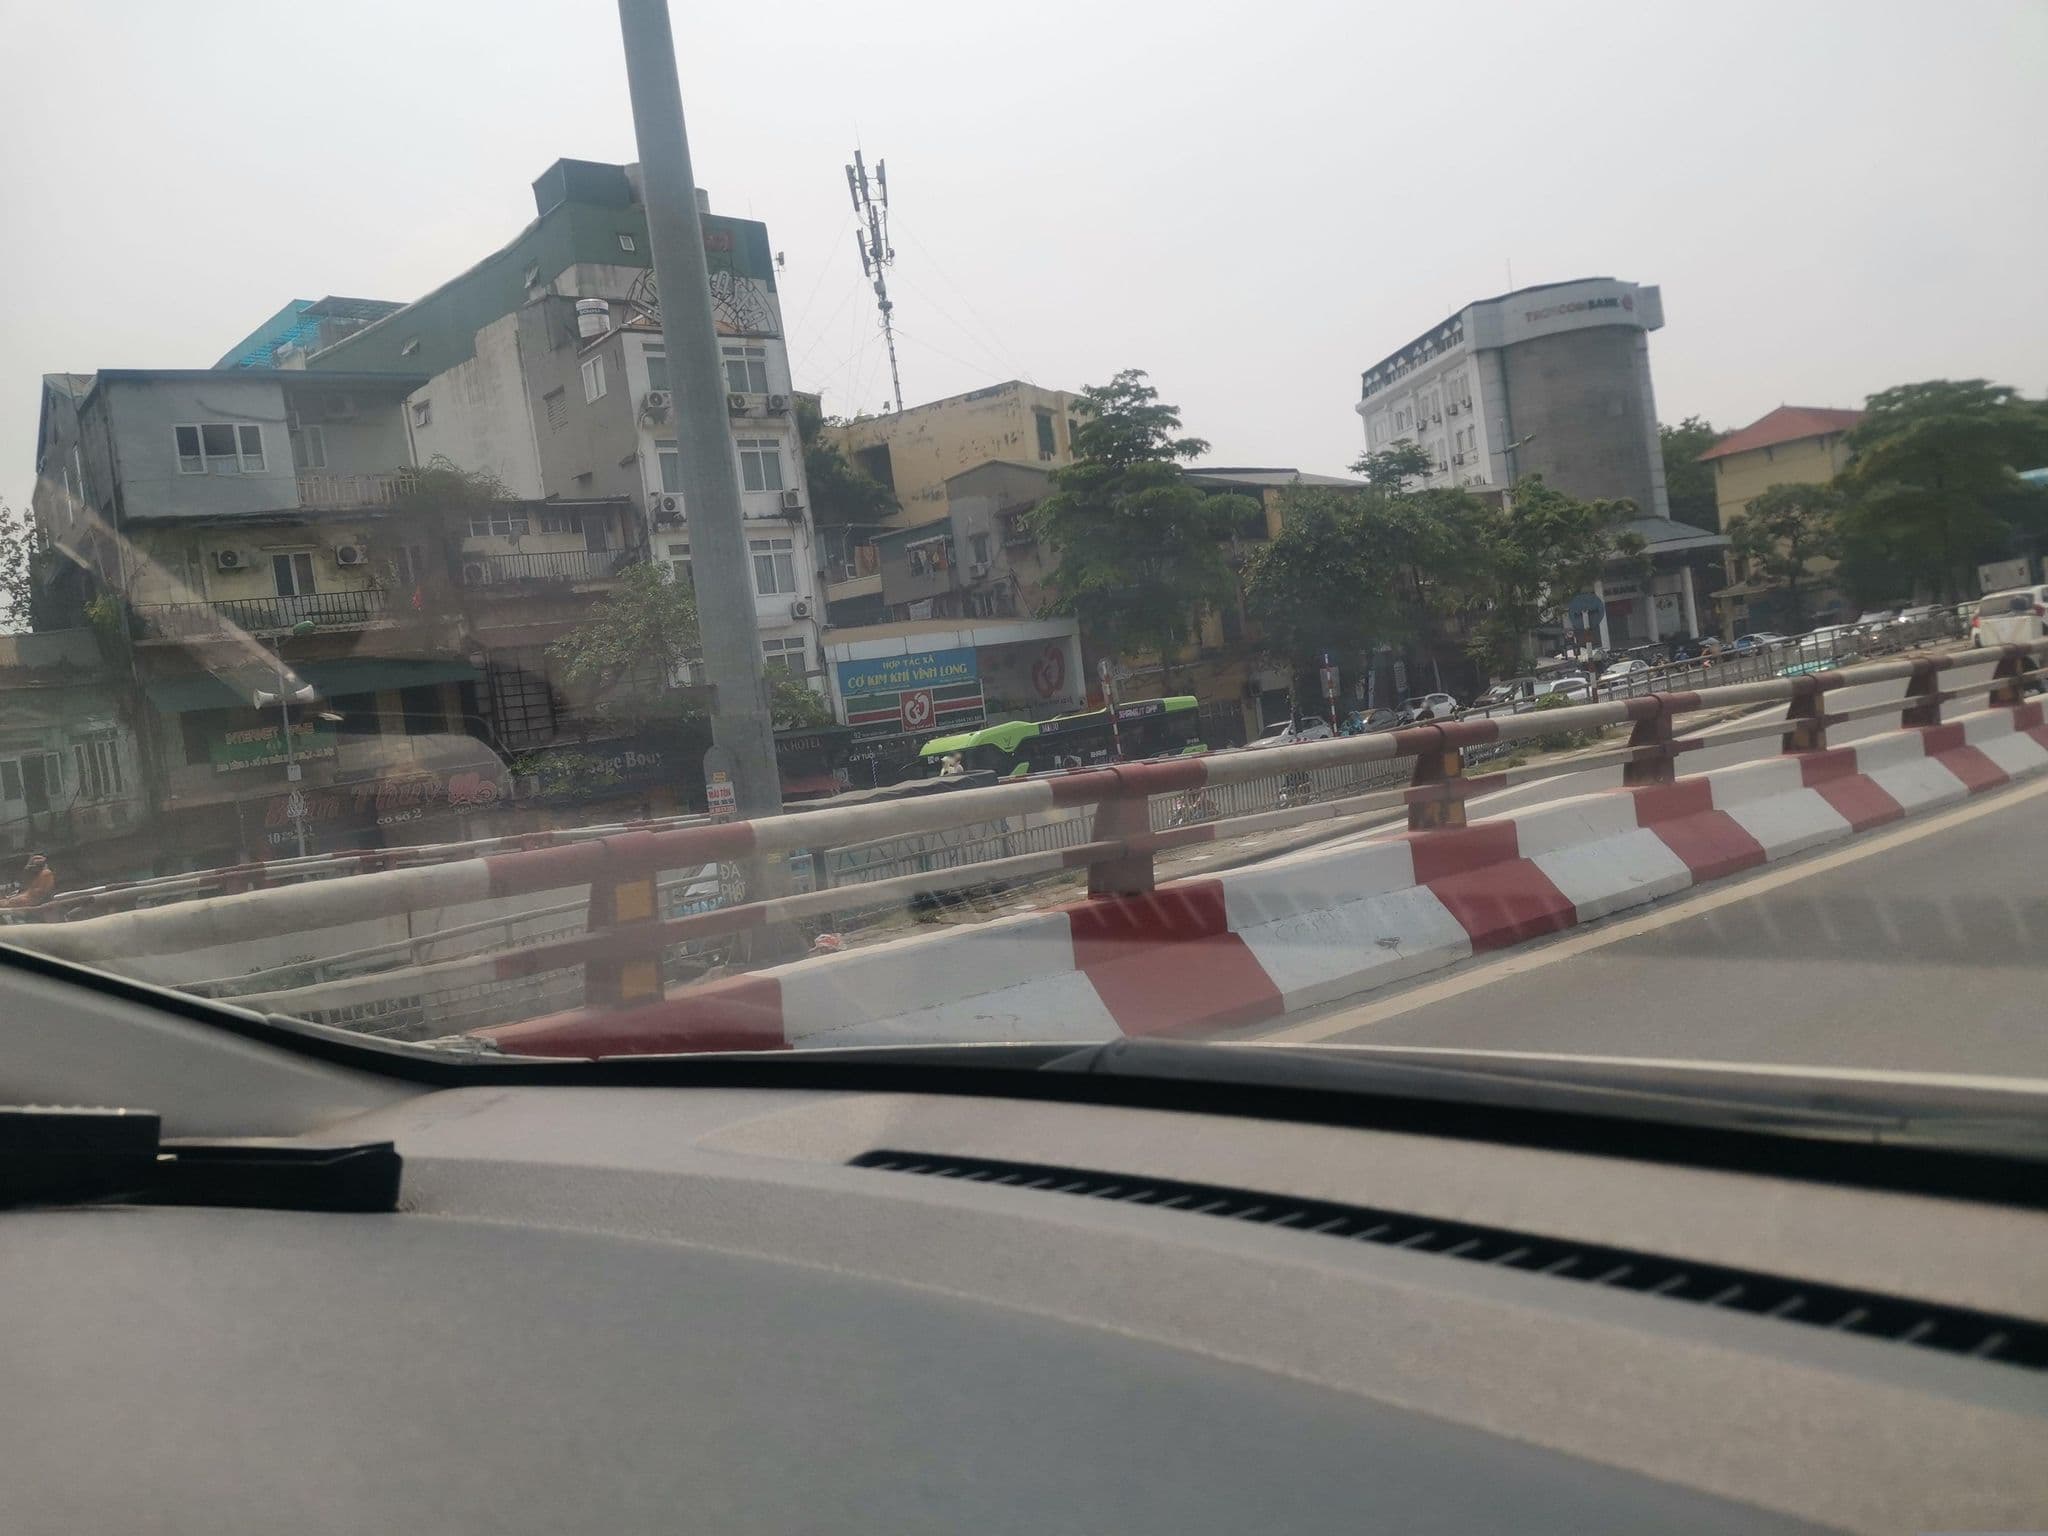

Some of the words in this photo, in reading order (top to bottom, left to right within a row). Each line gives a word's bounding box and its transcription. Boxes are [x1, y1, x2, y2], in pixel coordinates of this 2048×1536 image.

[904, 656, 920, 666] TÁC
[867, 674, 888, 687] KIM
[890, 668, 910, 683] KHÍ
[940, 664, 968, 676] LONG
[412, 808, 422, 818] 2
